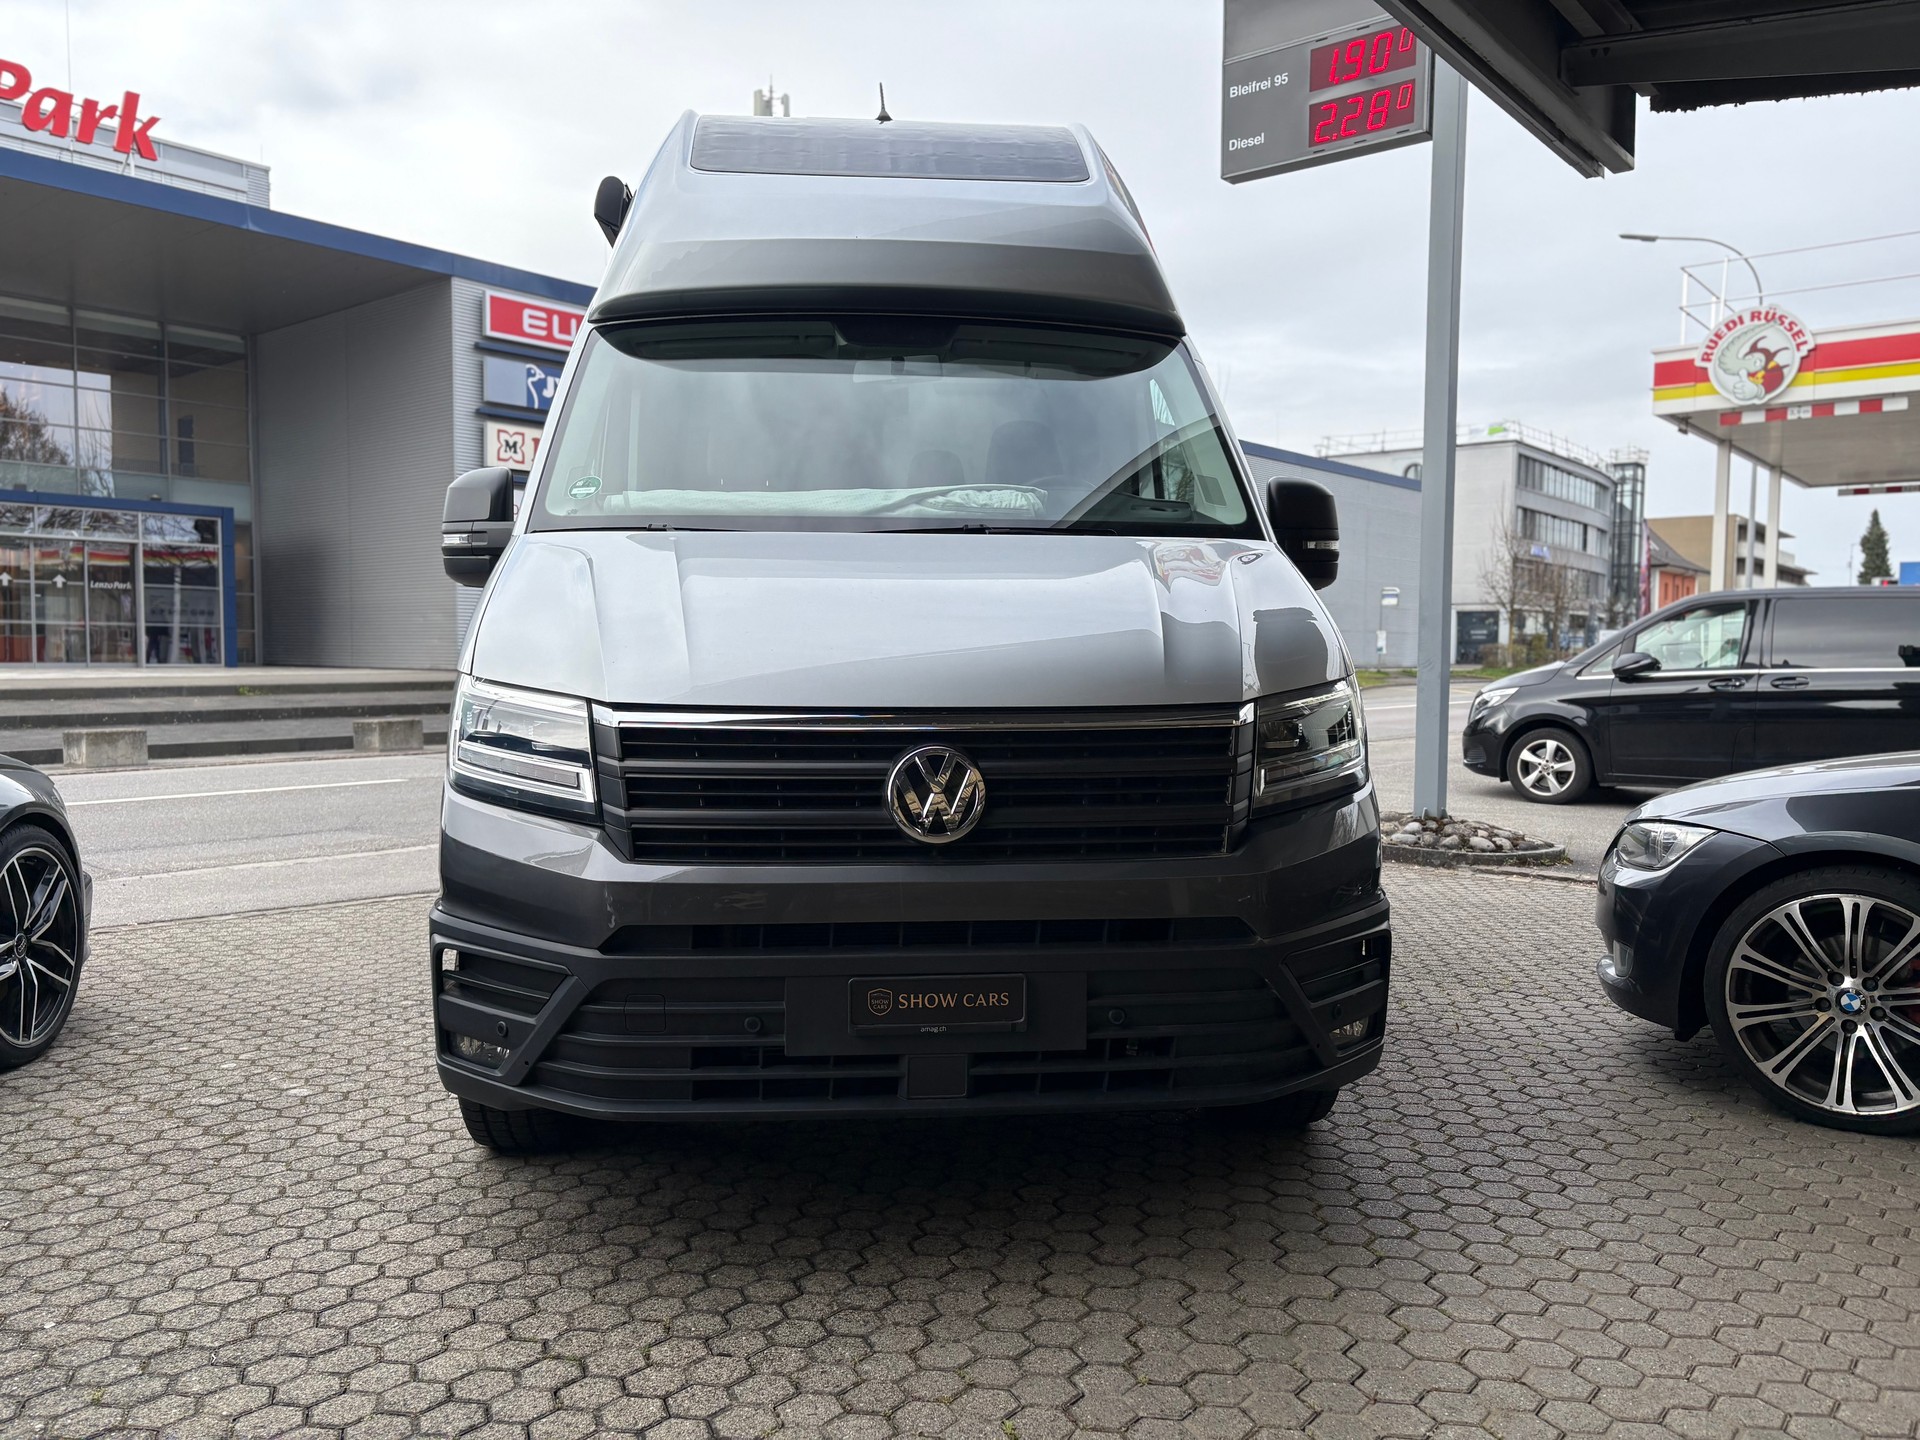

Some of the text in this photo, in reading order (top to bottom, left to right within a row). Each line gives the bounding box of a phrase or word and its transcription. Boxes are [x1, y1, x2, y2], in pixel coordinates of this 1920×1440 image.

[1229, 72, 1289, 98] Bleifrei 95
[0, 58, 161, 161] Park
[1228, 132, 1265, 151] Diesel
[1700, 306, 1809, 363] RUEDI RÜSSEL
[503, 438, 519, 455] M
[889, 748, 984, 842] VW
[898, 992, 1009, 1009] SHOW CARS
[920, 1025, 947, 1034] amag.ch
